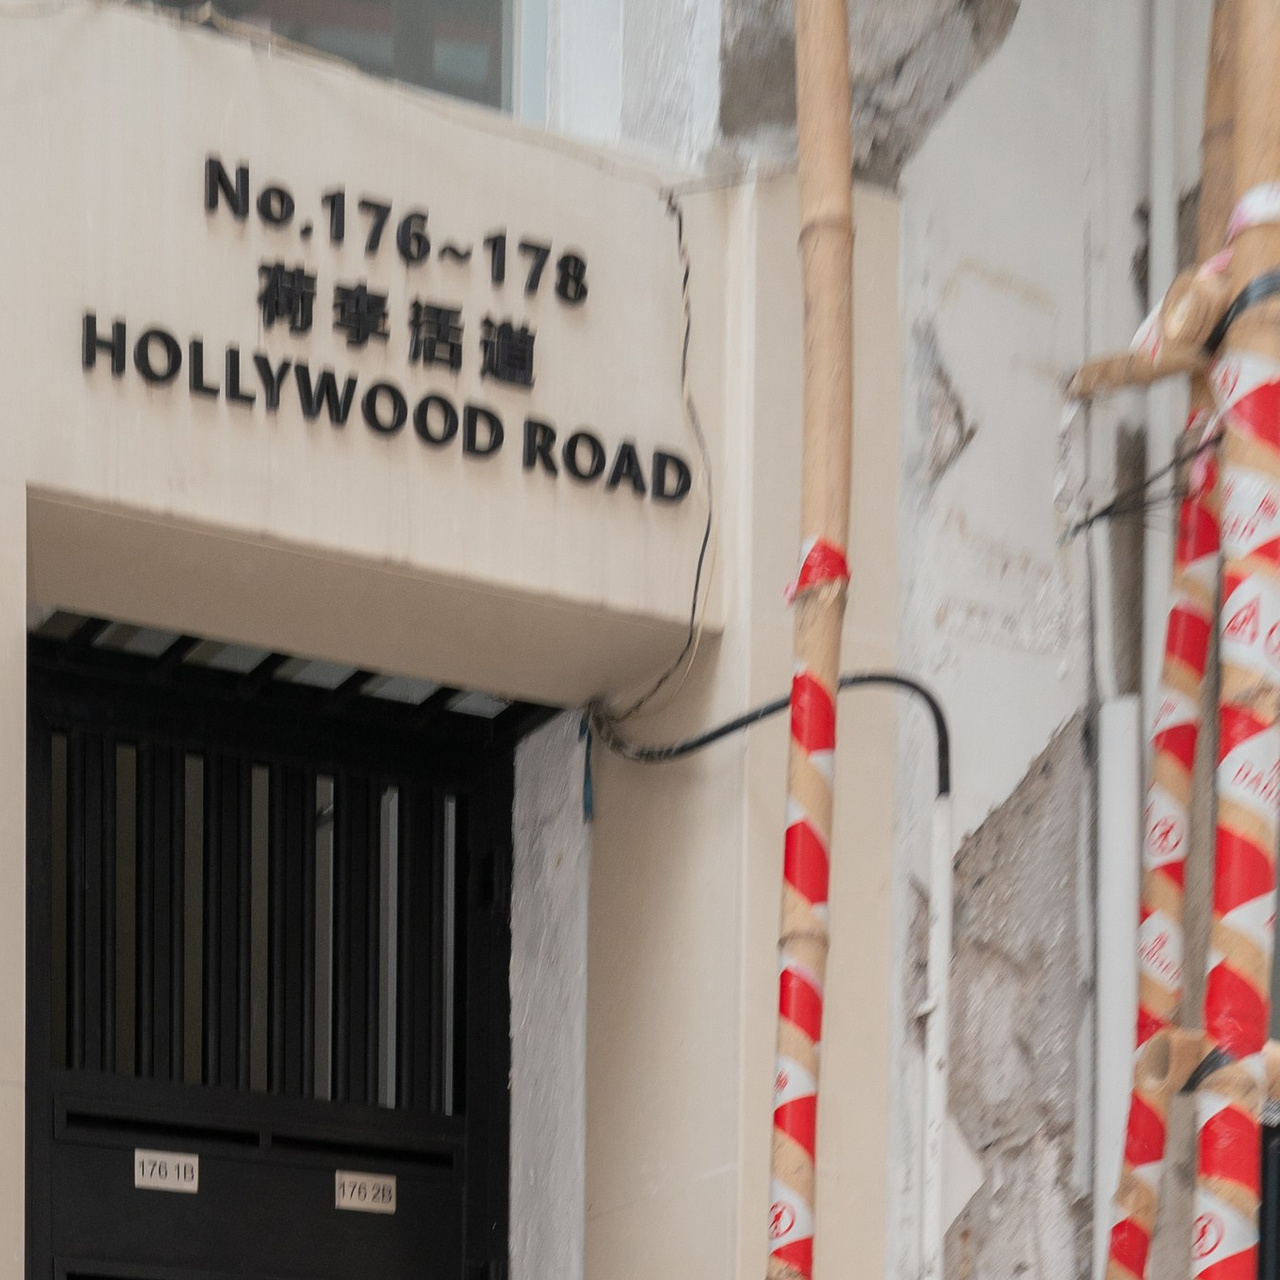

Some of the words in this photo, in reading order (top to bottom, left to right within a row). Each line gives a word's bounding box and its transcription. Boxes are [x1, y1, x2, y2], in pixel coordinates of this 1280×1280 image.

[256, 261, 537, 392] 荷李活道
[81, 312, 506, 460] HOLLYWOOD
[521, 417, 692, 505] ROAD
[138, 1158, 168, 1180] 176
[174, 1162, 194, 1182] 1B
[339, 1180, 367, 1201] 176
[371, 1183, 393, 1204] 2B
